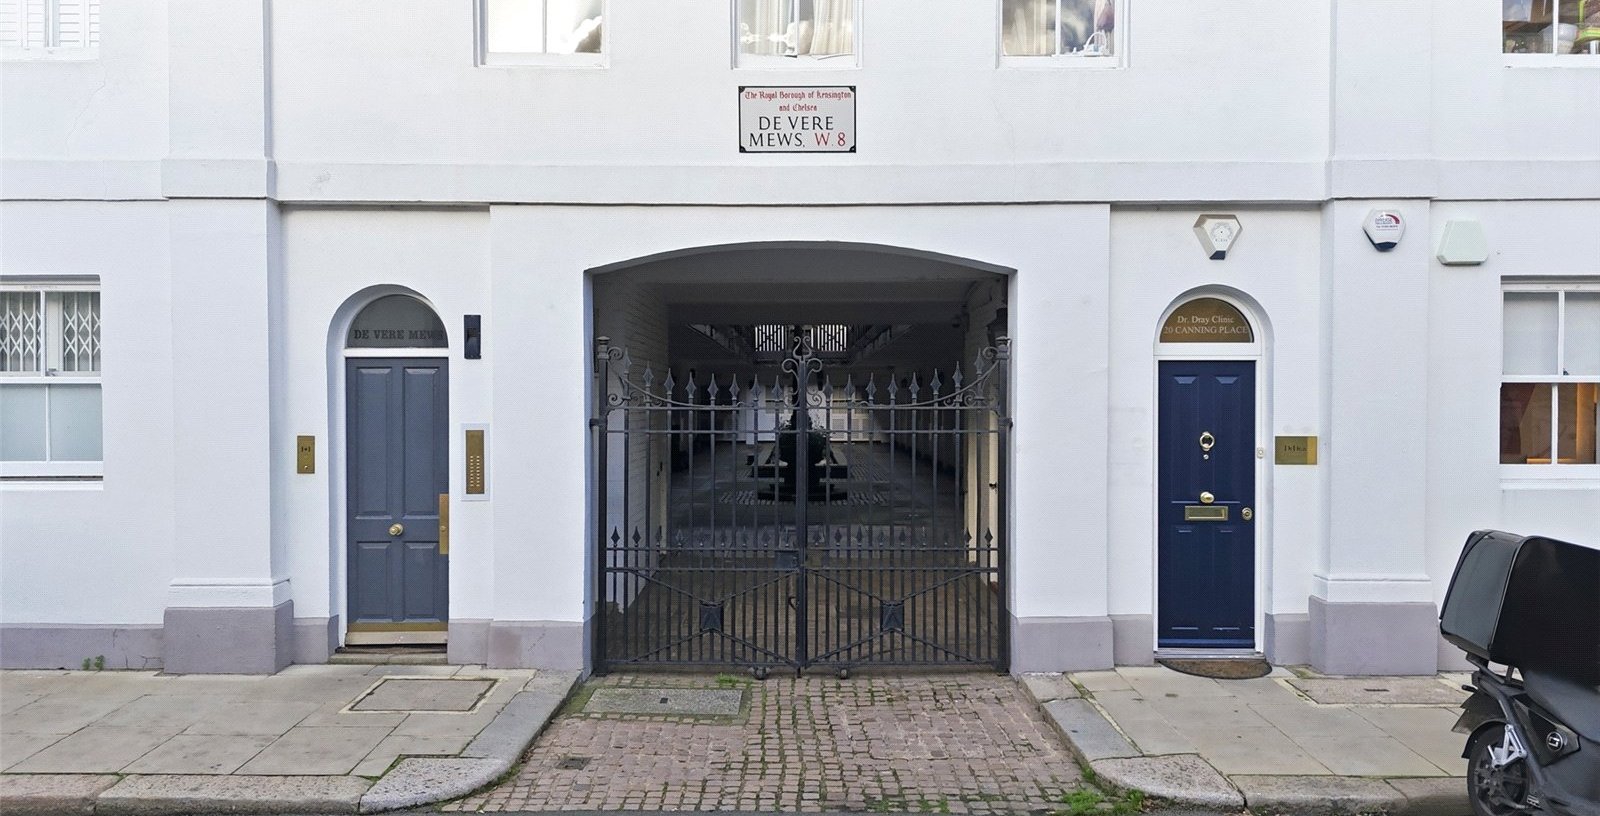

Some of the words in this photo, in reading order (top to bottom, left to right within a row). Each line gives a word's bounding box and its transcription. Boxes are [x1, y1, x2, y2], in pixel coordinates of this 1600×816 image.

[745, 91, 757, 99] The
[760, 91, 777, 101] Royal
[780, 91, 805, 100] Borough
[808, 91, 814, 99] of
[817, 90, 851, 100] Kensington
[759, 116, 781, 130] DE
[788, 116, 834, 130] VERE
[1177, 315, 1190, 324] Dr.
[1191, 315, 1209, 325] Dray
[1211, 315, 1235, 324] Clinic
[354, 329, 369, 340] DE
[372, 329, 405, 340] VERE
[1175, 326, 1217, 334] CANNING
[1219, 326, 1248, 334] PLACE
